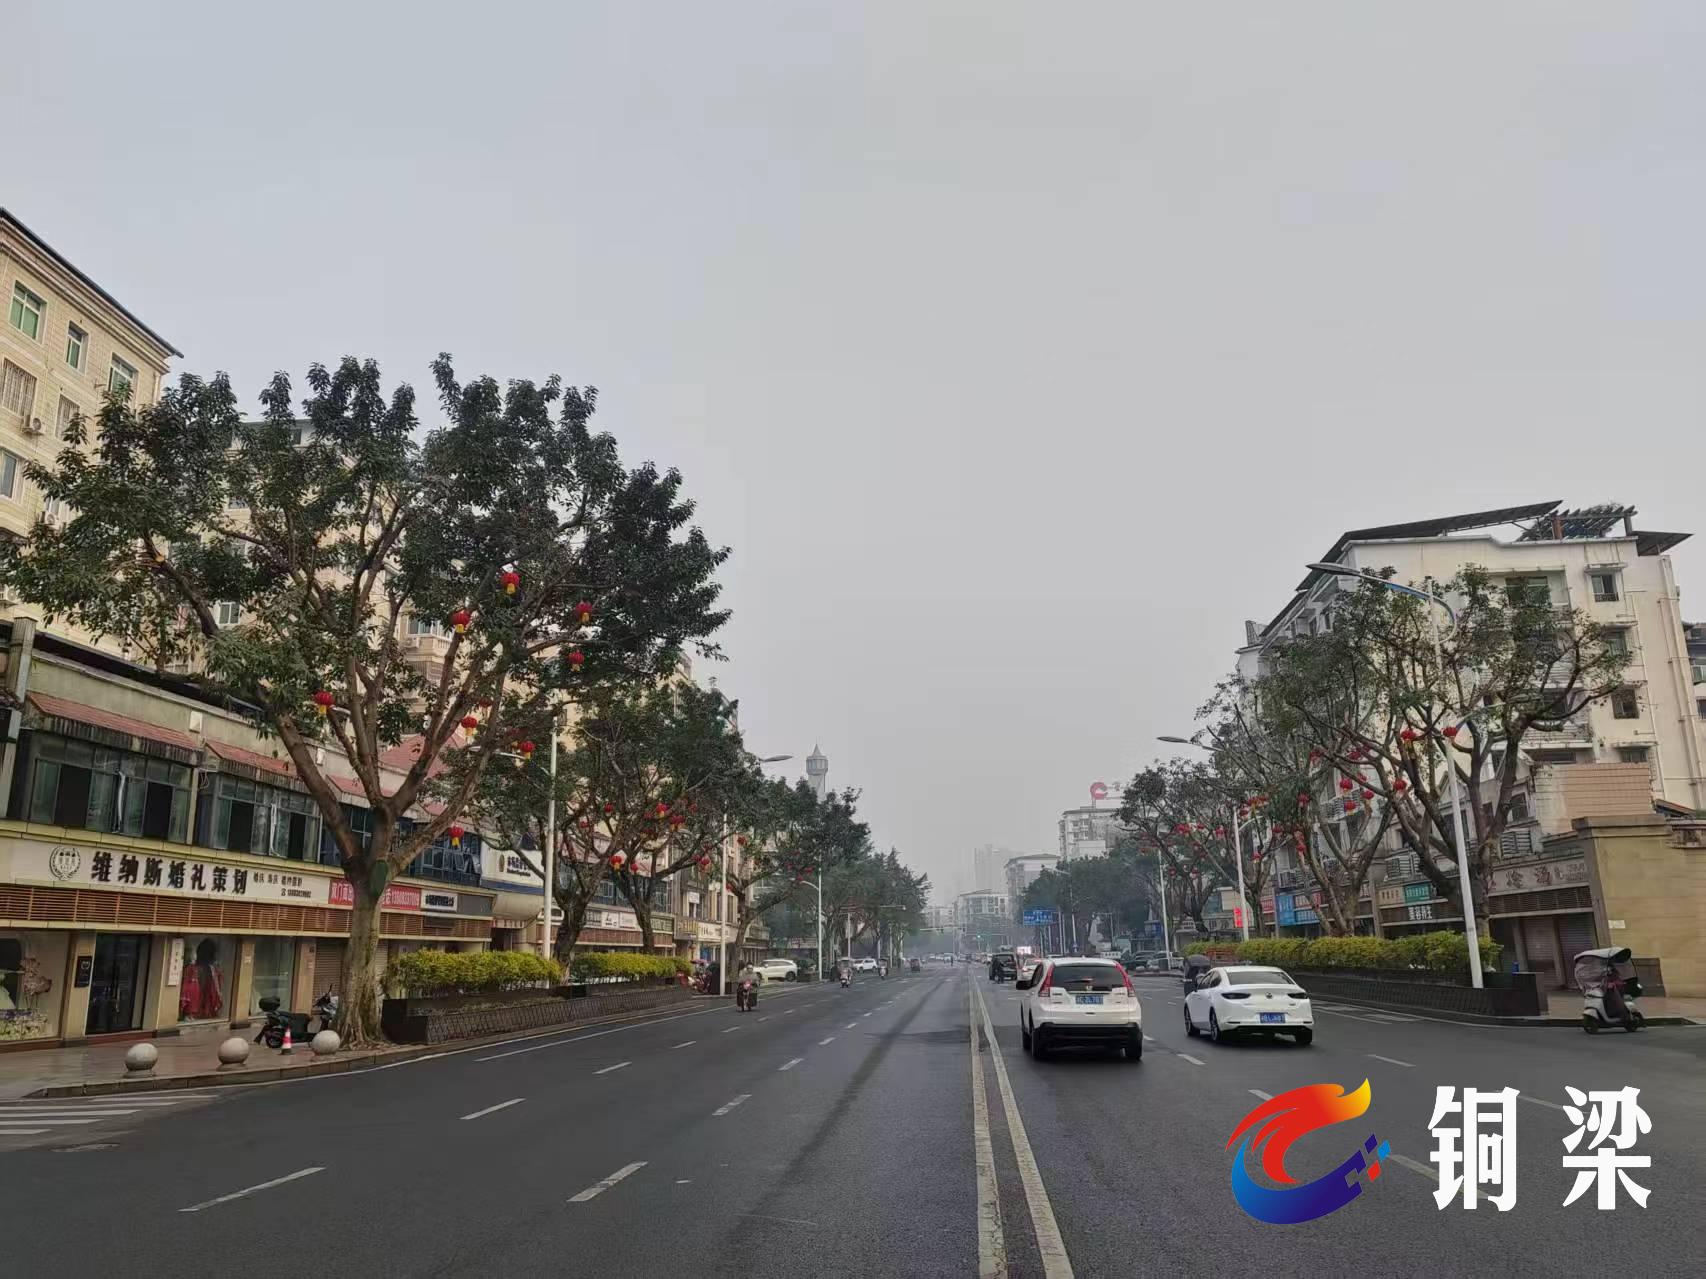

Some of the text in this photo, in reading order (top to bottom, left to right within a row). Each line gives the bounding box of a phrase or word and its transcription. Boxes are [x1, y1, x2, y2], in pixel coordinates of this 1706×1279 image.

[91, 850, 249, 895] 维纳斯婚礼策划
